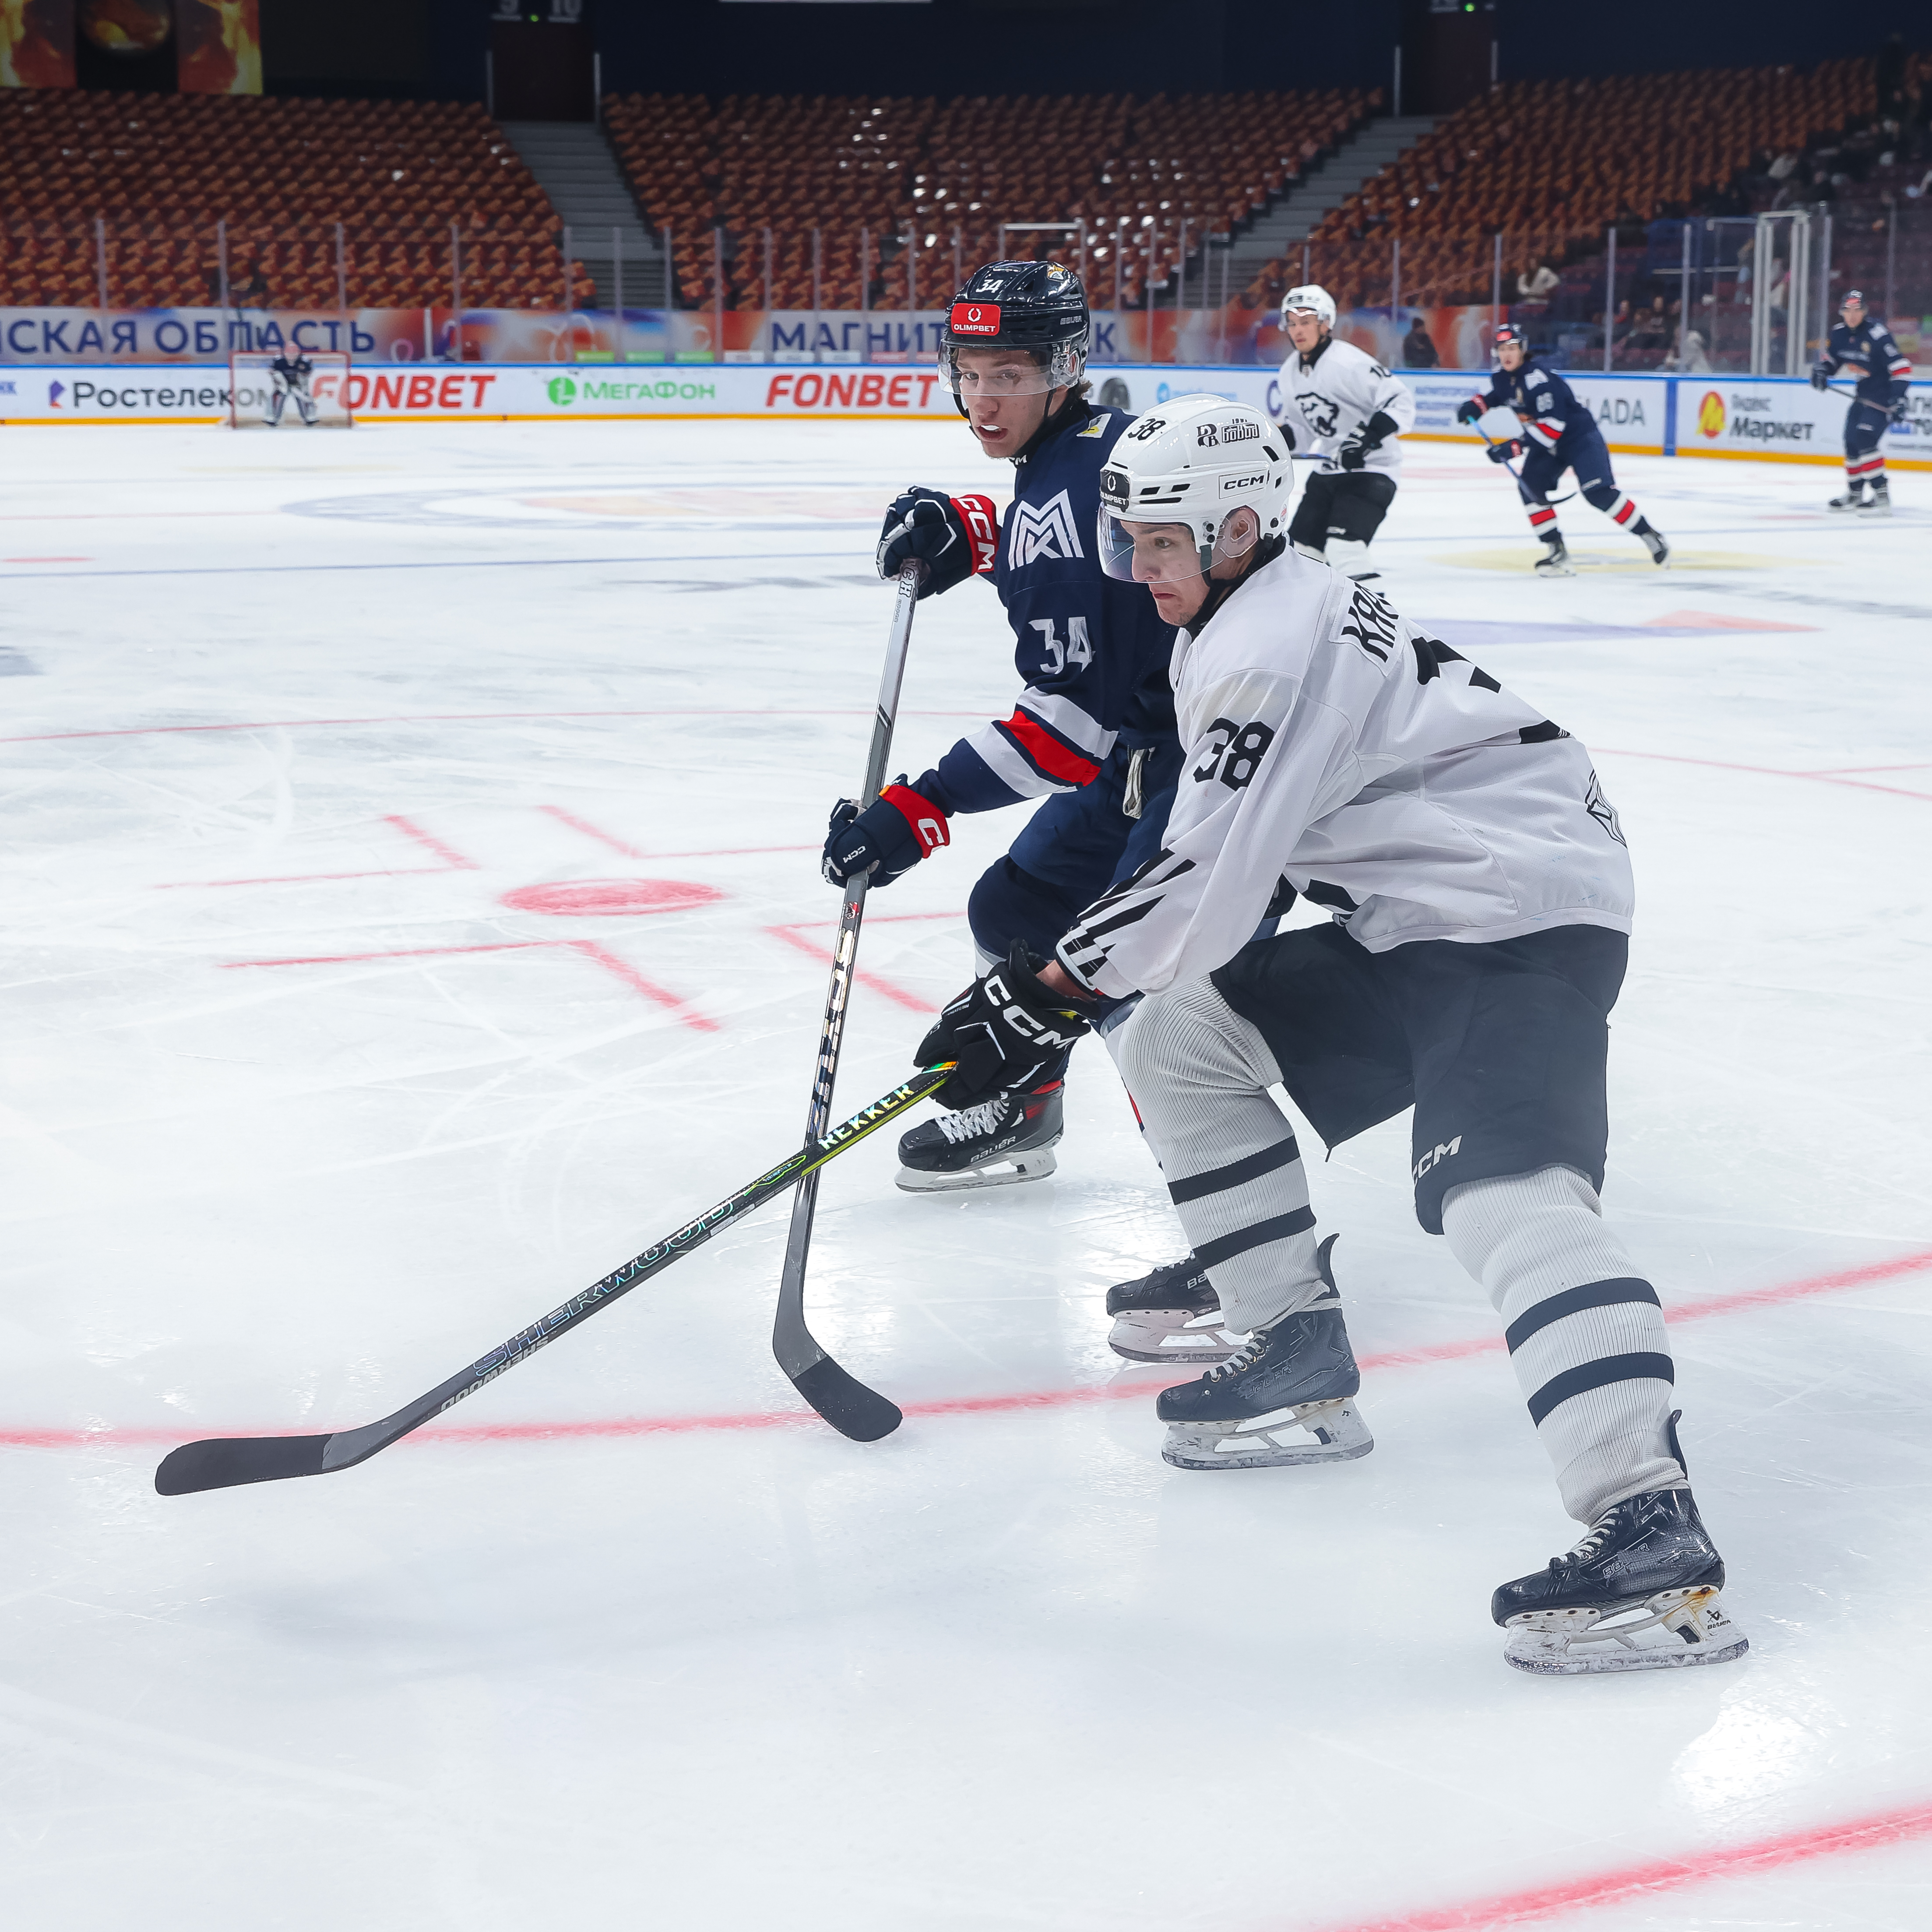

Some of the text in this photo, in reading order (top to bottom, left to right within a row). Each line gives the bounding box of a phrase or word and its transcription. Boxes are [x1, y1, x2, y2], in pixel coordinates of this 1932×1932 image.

[976, 279, 1004, 293] 34
[0, 320, 375, 353] СКАЯ ОБЛАСТЬ
[771, 322, 1116, 352] МАГНИТК
[954, 324, 996, 332] OLIMPBET
[312, 375, 496, 409] FONBET
[766, 374, 939, 408] FONBET
[1127, 418, 1166, 441] 38
[1100, 492, 1126, 505] OLIMPBET
[1224, 475, 1265, 490] CCM
[961, 497, 995, 571] CCM
[1028, 616, 1095, 674] 34
[1192, 717, 1275, 792] 38
[843, 845, 866, 863] CCM
[984, 975, 1079, 1051] CCM
[818, 1084, 914, 1151] REKKER
[970, 1136, 1016, 1163] BAUER
[473, 1200, 733, 1376] SHERWOOD
[441, 1336, 549, 1411] SHERWOOD
